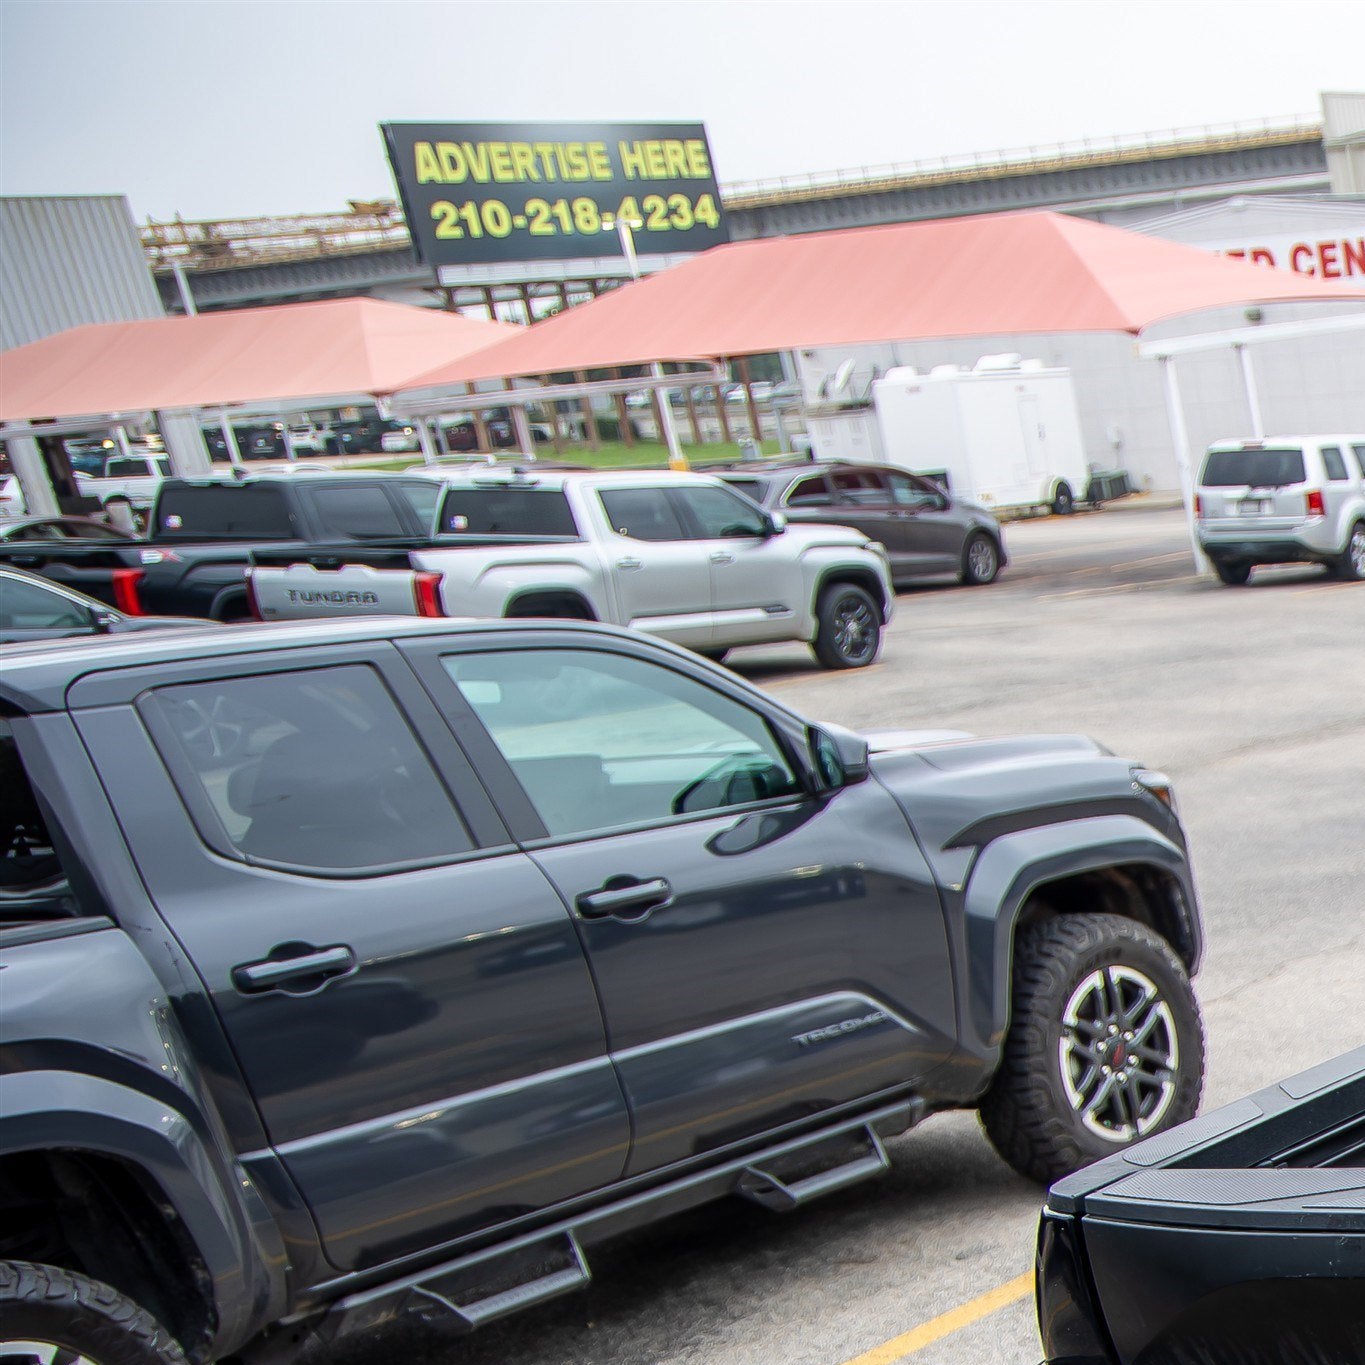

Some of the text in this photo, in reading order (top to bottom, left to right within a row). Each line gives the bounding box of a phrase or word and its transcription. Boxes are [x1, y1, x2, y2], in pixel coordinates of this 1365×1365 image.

[414, 139, 712, 185] ADVERTISE HERE
[431, 193, 720, 240] 210-218-4234
[285, 588, 381, 606] TUNDRA
